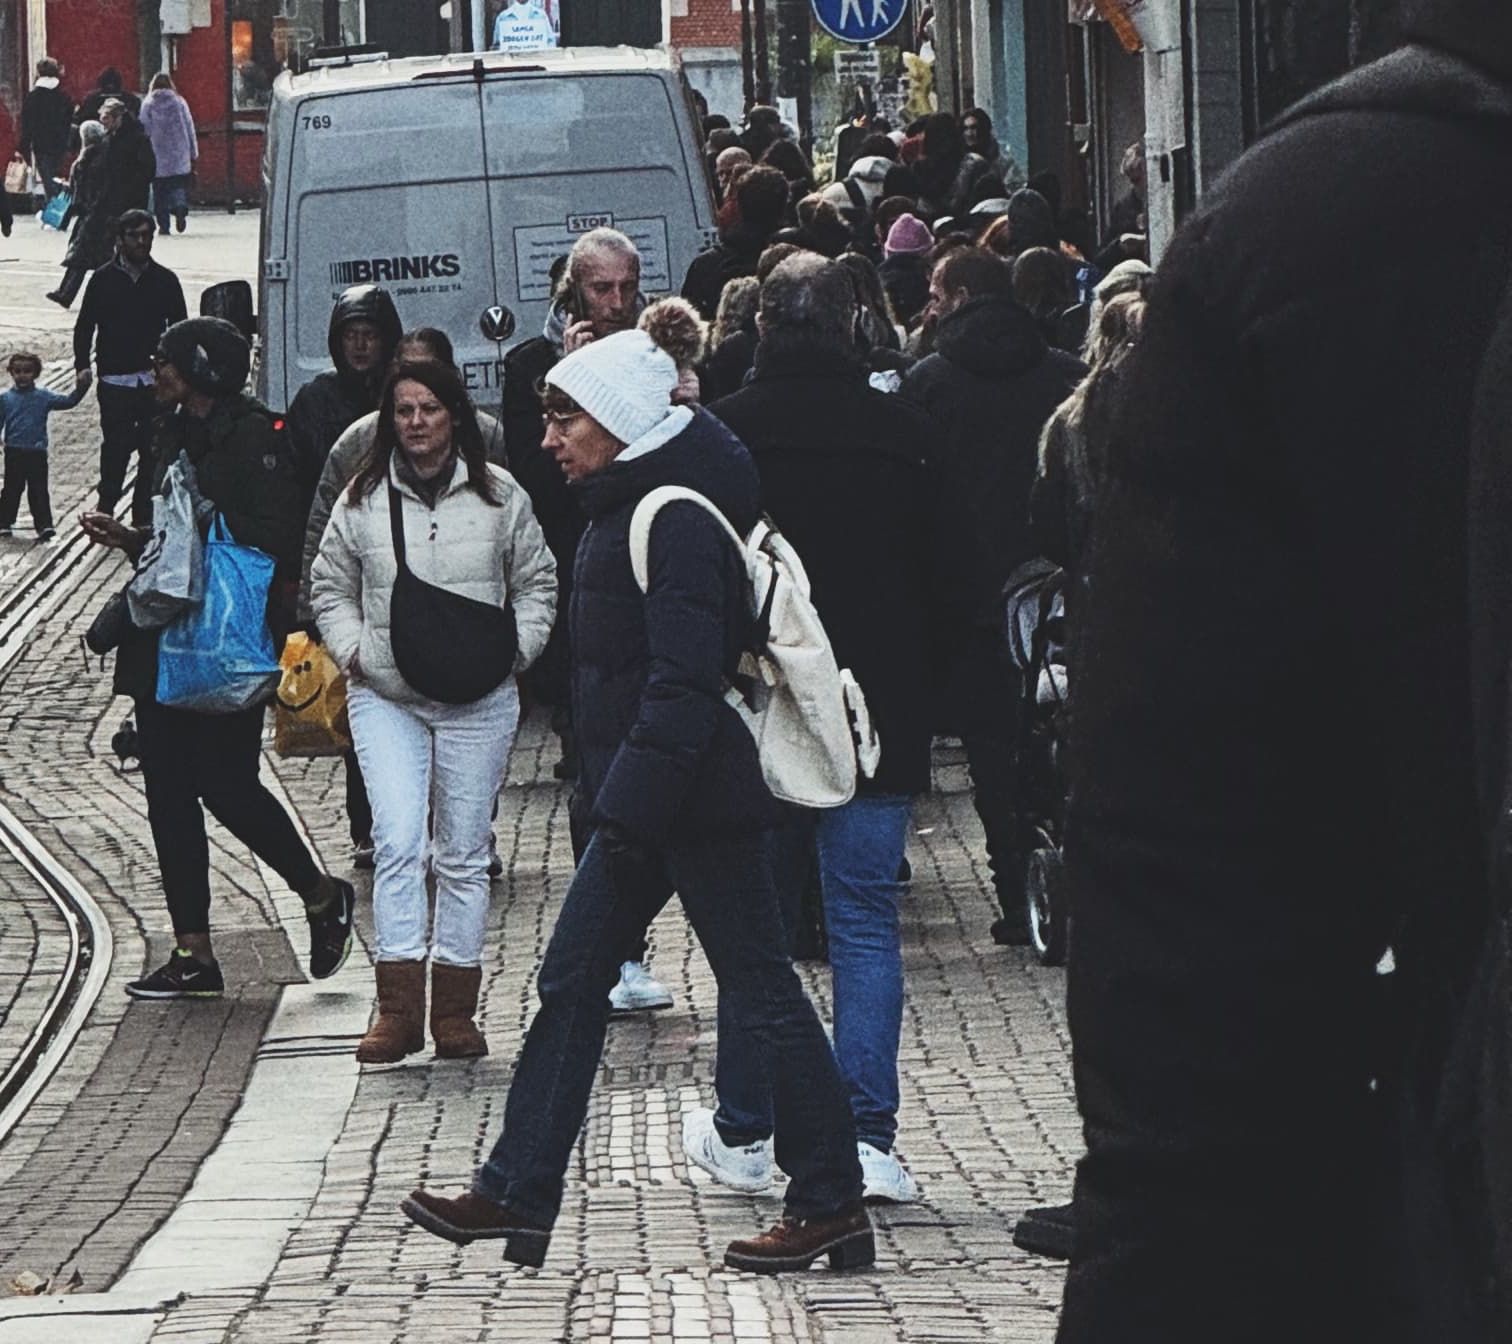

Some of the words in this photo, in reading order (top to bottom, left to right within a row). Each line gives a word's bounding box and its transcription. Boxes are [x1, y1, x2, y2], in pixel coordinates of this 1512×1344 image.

[302, 115, 332, 131] 769
[572, 217, 609, 230] STOP
[352, 254, 461, 283] BRINKS
